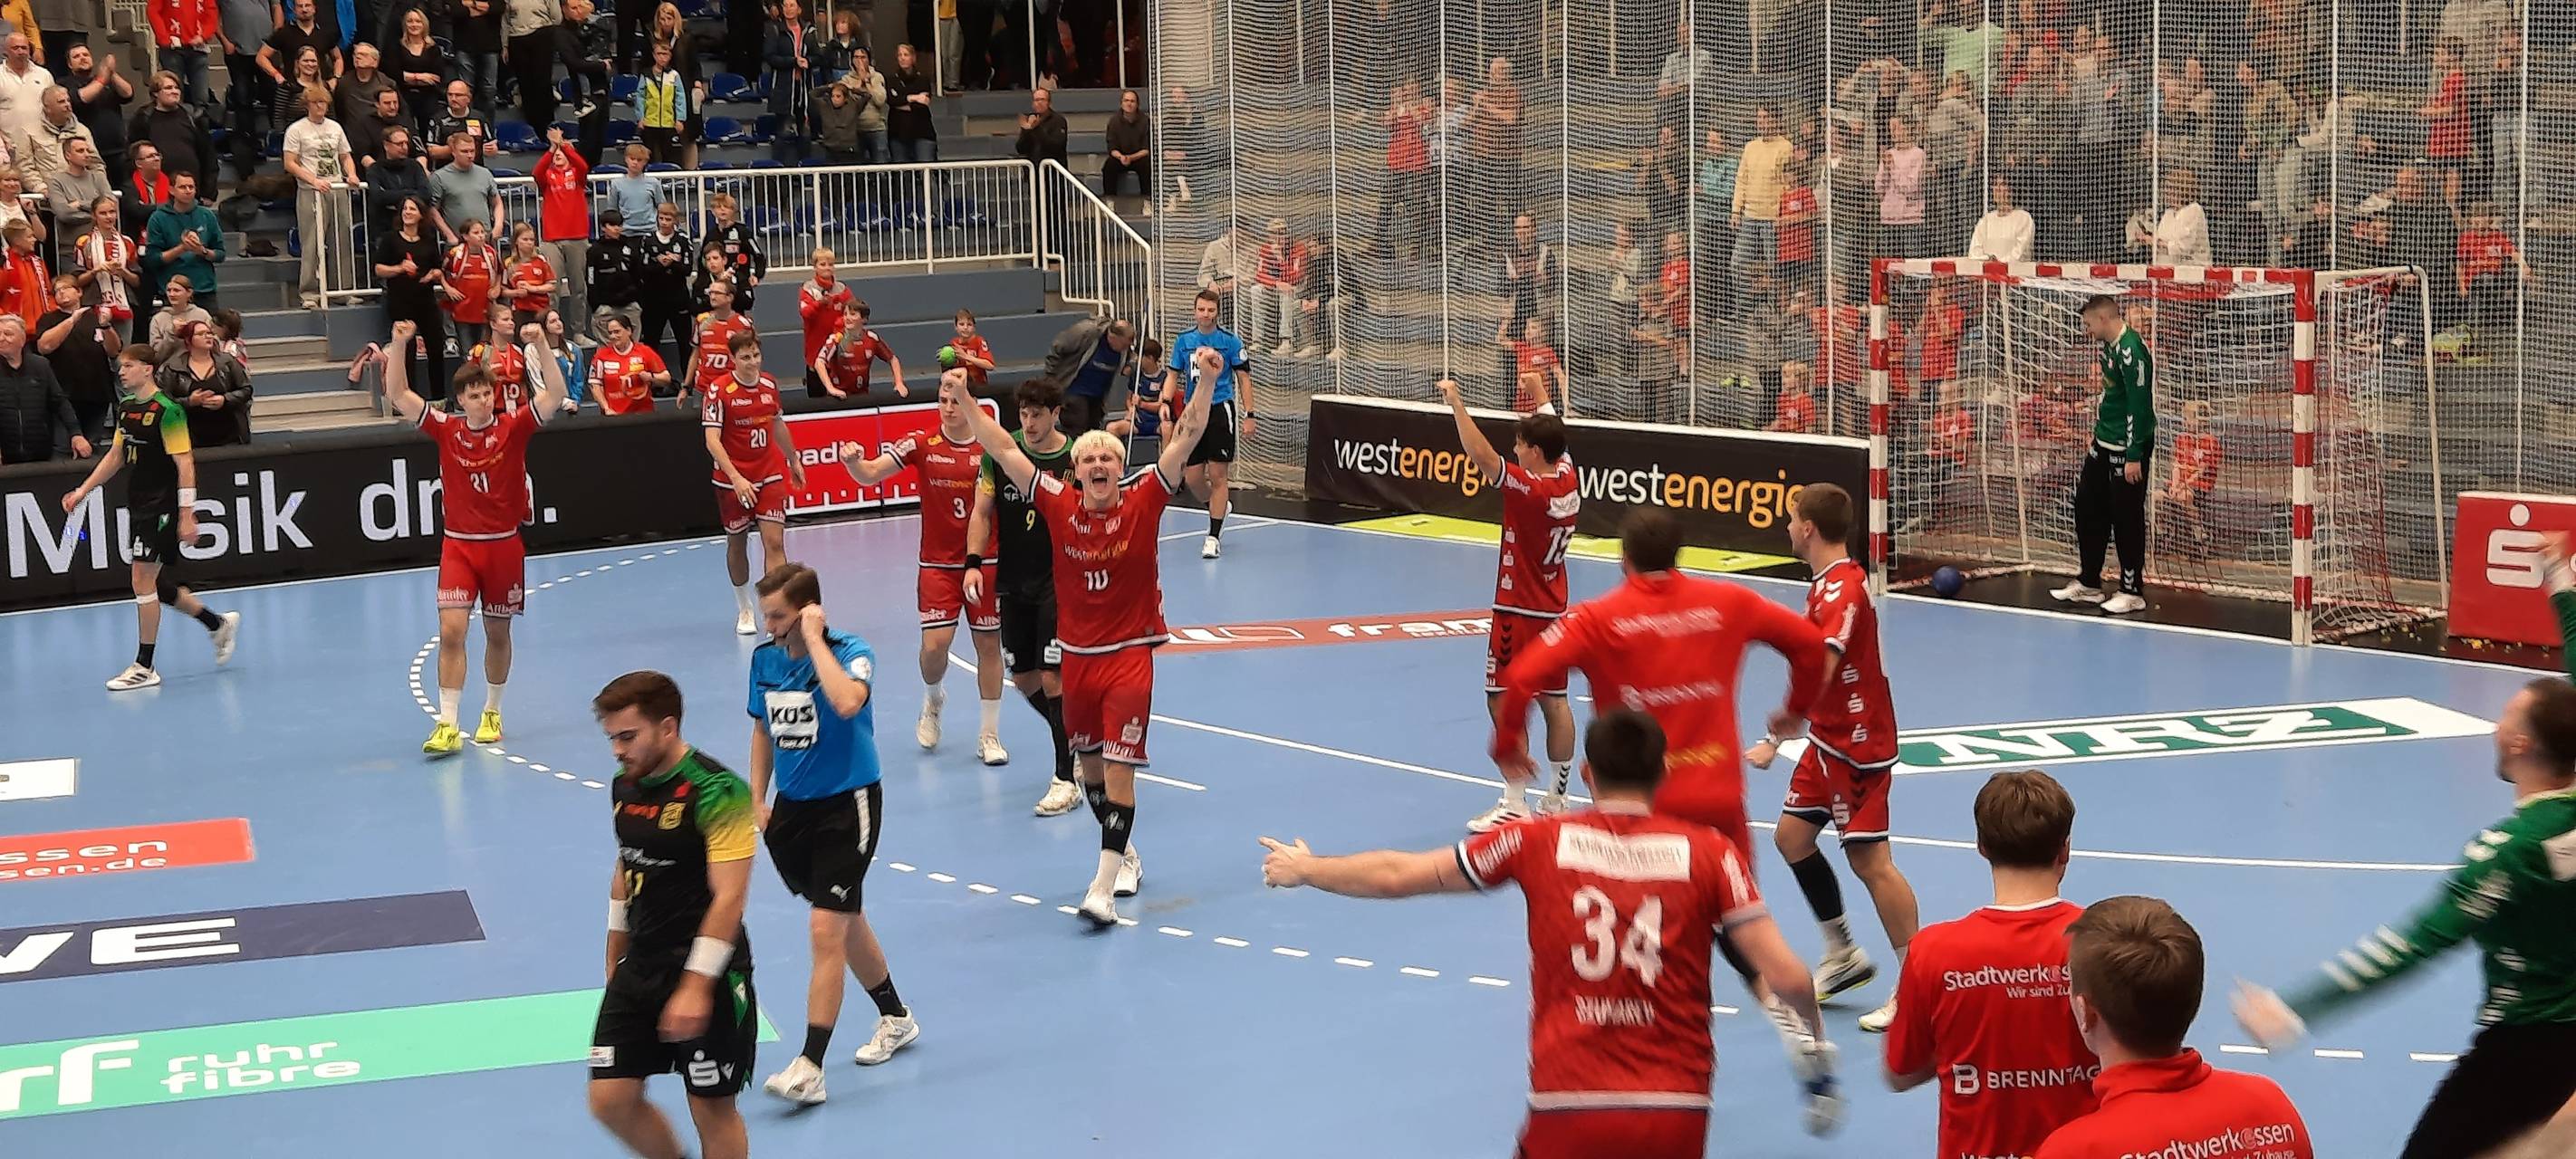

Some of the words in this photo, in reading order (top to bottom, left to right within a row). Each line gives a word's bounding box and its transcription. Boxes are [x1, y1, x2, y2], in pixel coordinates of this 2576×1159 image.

[750, 428, 767, 448] 20
[469, 471, 490, 493] 21
[1334, 437, 1494, 497] westenerg
[954, 497, 967, 519] 3
[1025, 509, 1036, 531] 9
[1939, 709, 2389, 765] NRZ
[1571, 884, 1664, 989] 34
[168, 1040, 339, 1073] ruhr
[160, 1060, 361, 1094] fibre
